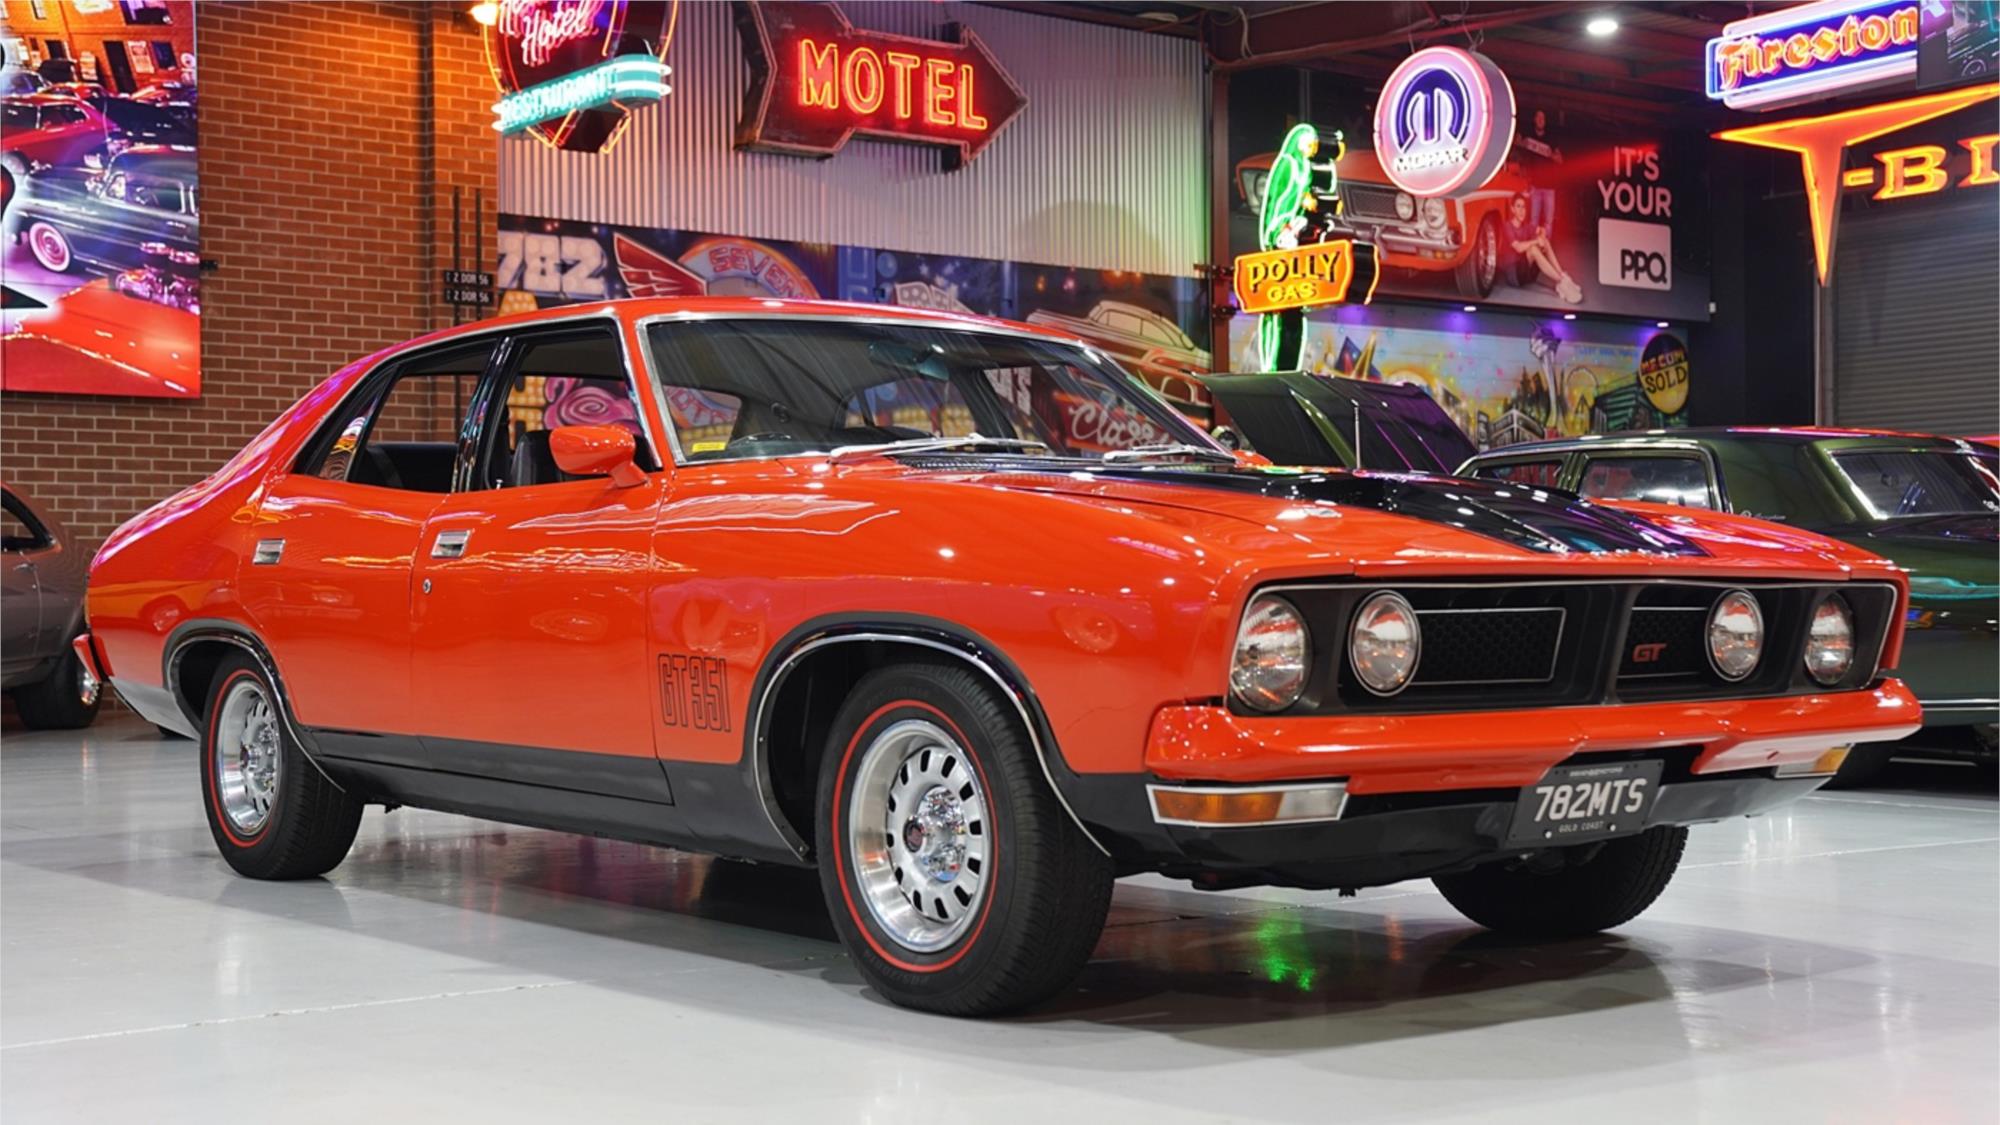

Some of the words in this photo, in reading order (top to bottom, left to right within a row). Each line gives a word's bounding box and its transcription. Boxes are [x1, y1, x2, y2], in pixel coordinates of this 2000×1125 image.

[1716, 6, 1918, 90] Fireston
[799, 38, 988, 131] MOTEL
[1614, 145, 1660, 182] IT'S
[1597, 179, 1672, 218] YOUR
[498, 230, 607, 298] 782
[1246, 250, 1341, 293] POLLY
[1621, 248, 1667, 284] PPQ
[1266, 281, 1318, 303] GAS
[1645, 366, 1688, 394] SOLD
[1632, 643, 1668, 663] GT
[657, 653, 732, 733] GT351
[1534, 777, 1648, 822] 782MTS
[1558, 822, 1578, 833] GOLD
[1581, 820, 1605, 832] COAST
